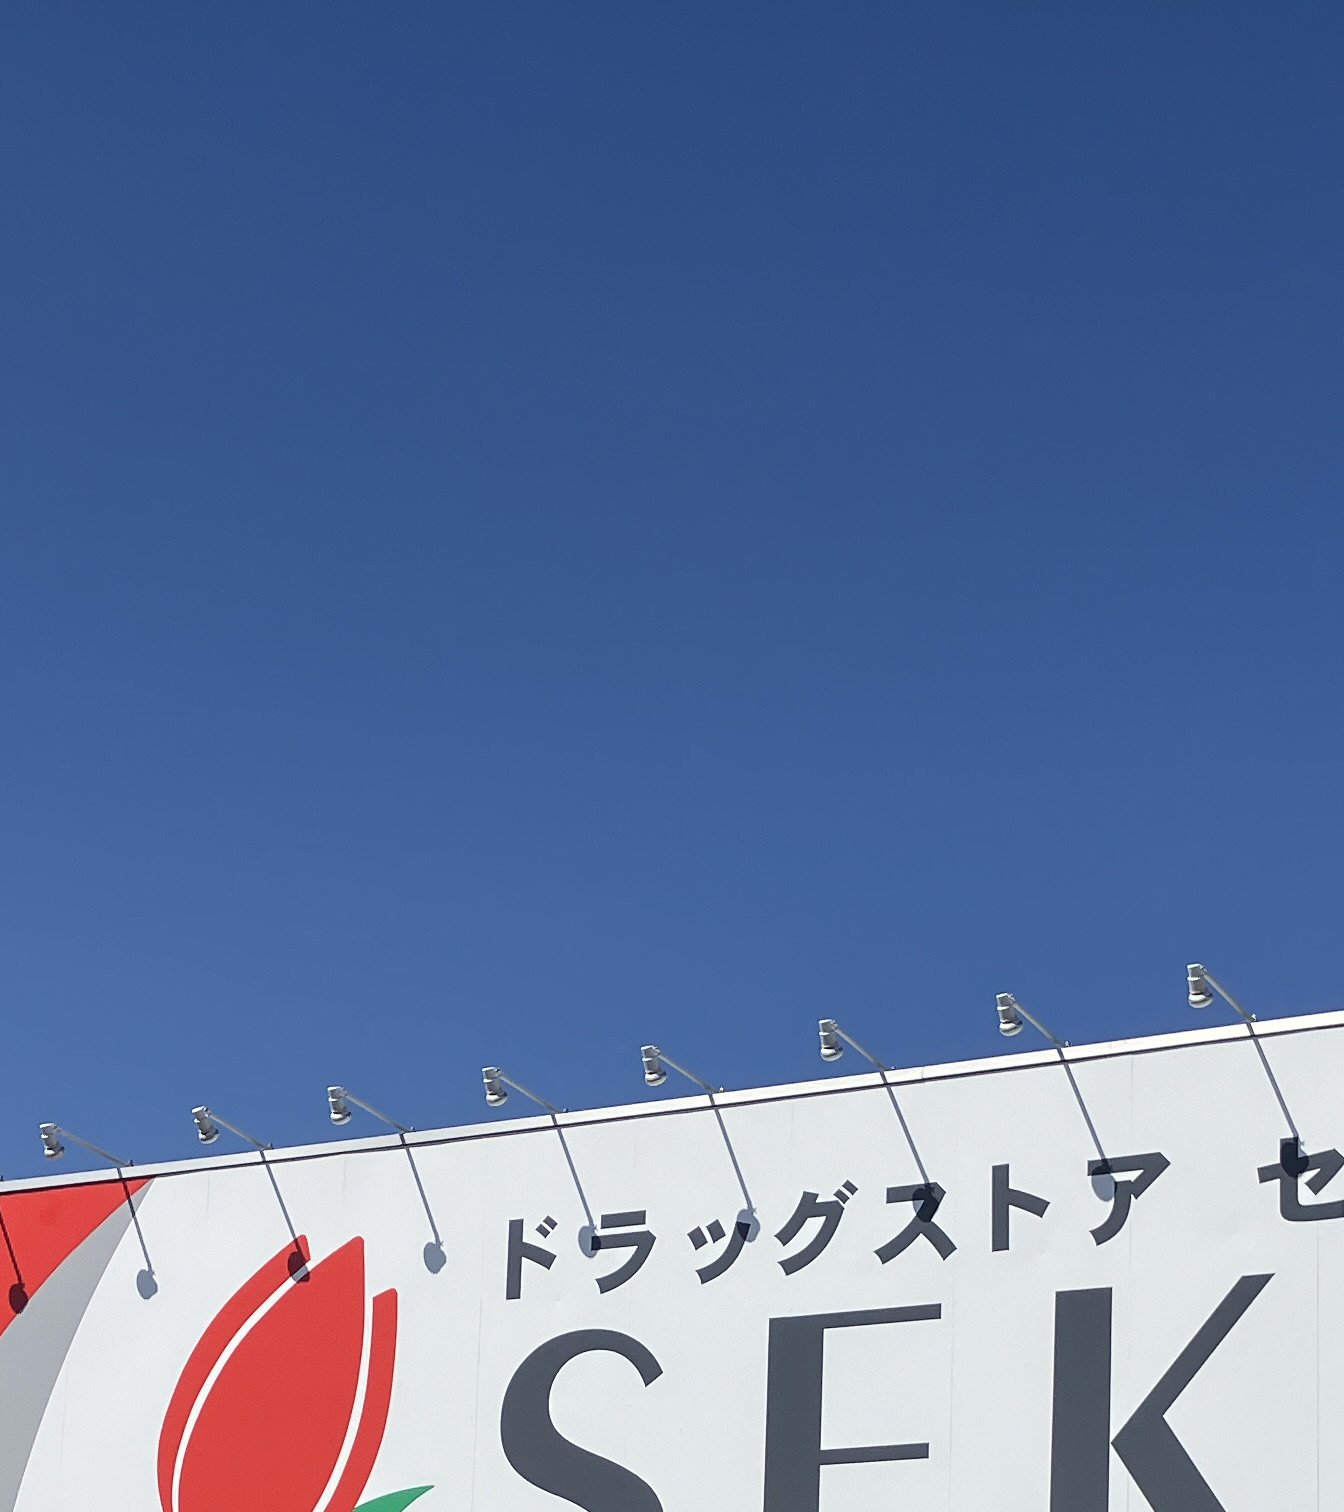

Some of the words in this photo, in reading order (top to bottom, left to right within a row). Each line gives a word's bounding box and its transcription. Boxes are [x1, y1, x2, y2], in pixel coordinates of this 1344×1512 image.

[506, 1151, 1171, 1300] ドラッグストア
